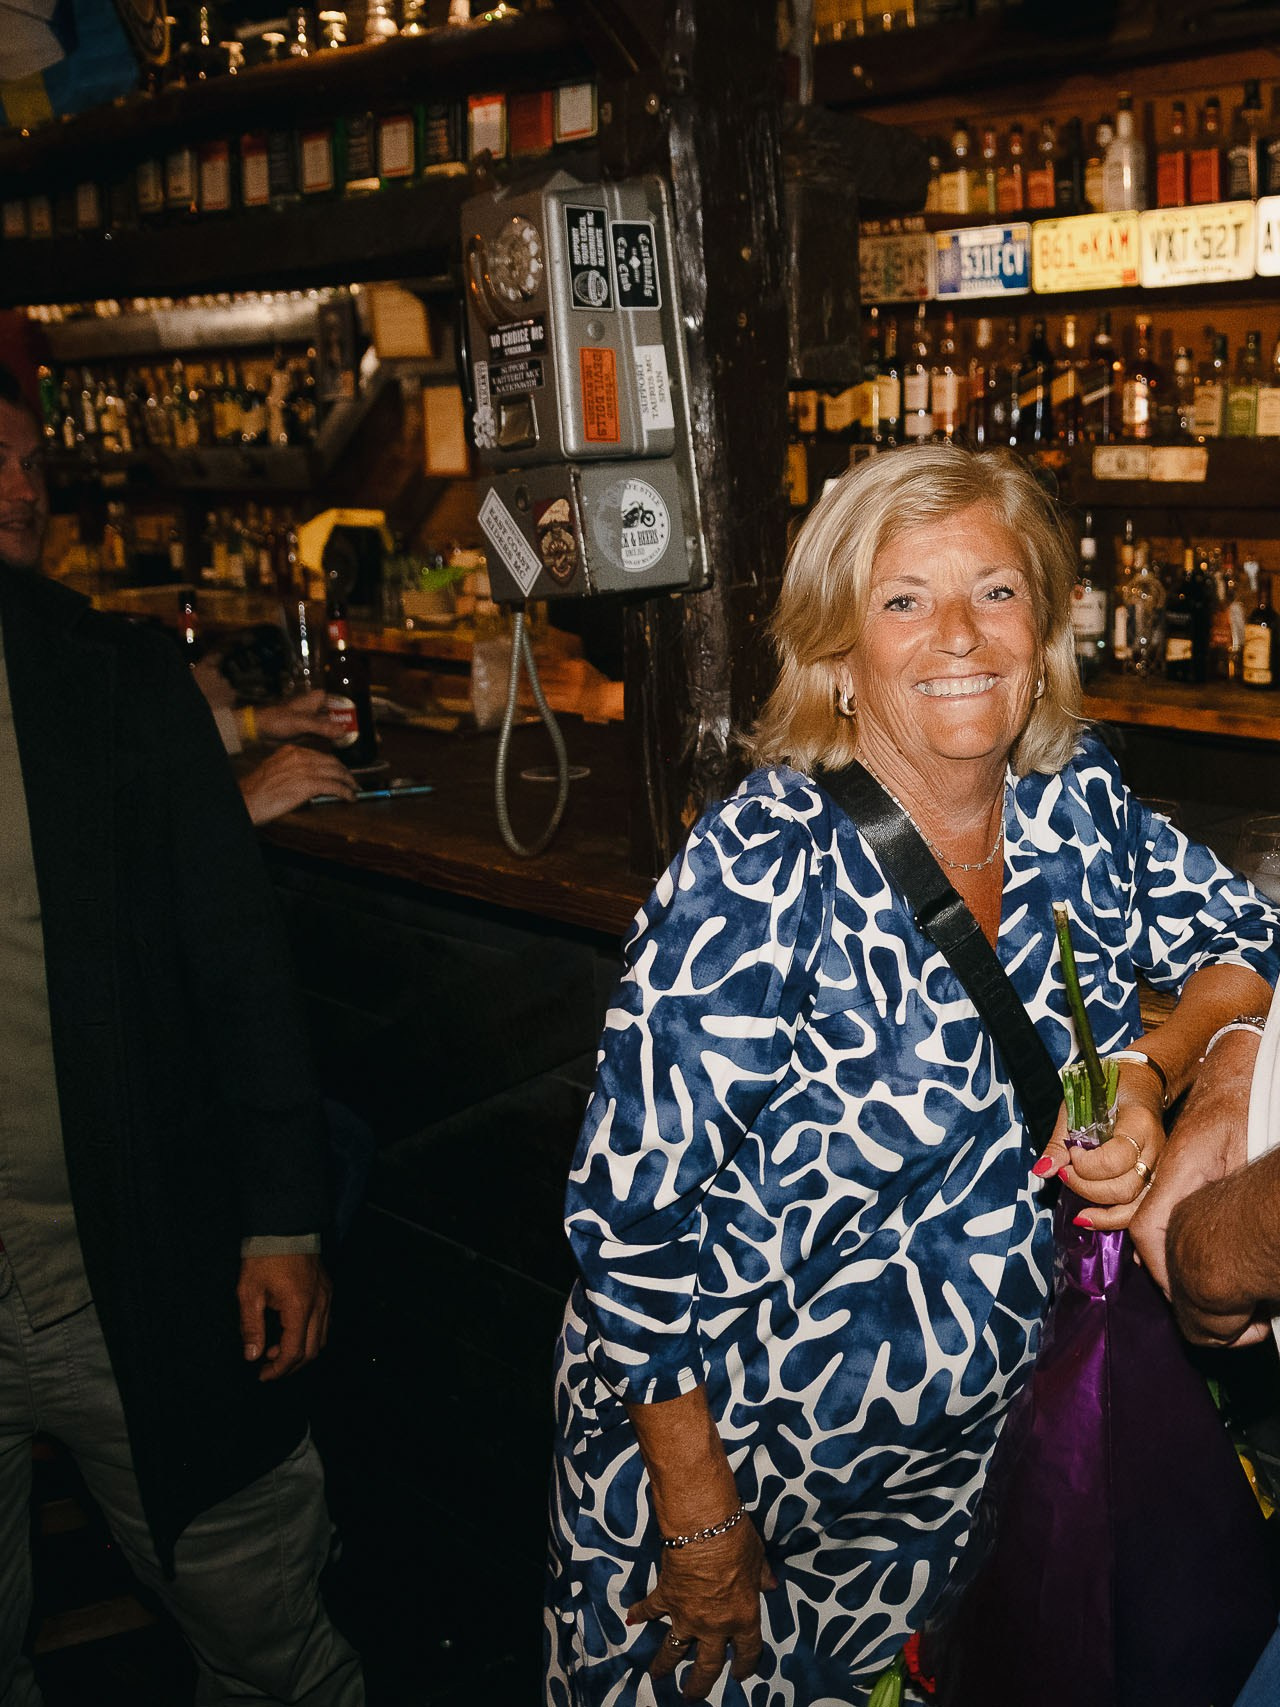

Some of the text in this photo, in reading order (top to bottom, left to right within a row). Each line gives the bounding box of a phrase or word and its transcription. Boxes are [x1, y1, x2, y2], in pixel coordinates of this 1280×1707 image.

[637, 363, 649, 413] SUPPORT
[656, 370, 666, 403] SPAIN
[489, 507, 530, 572] EAST COAST
